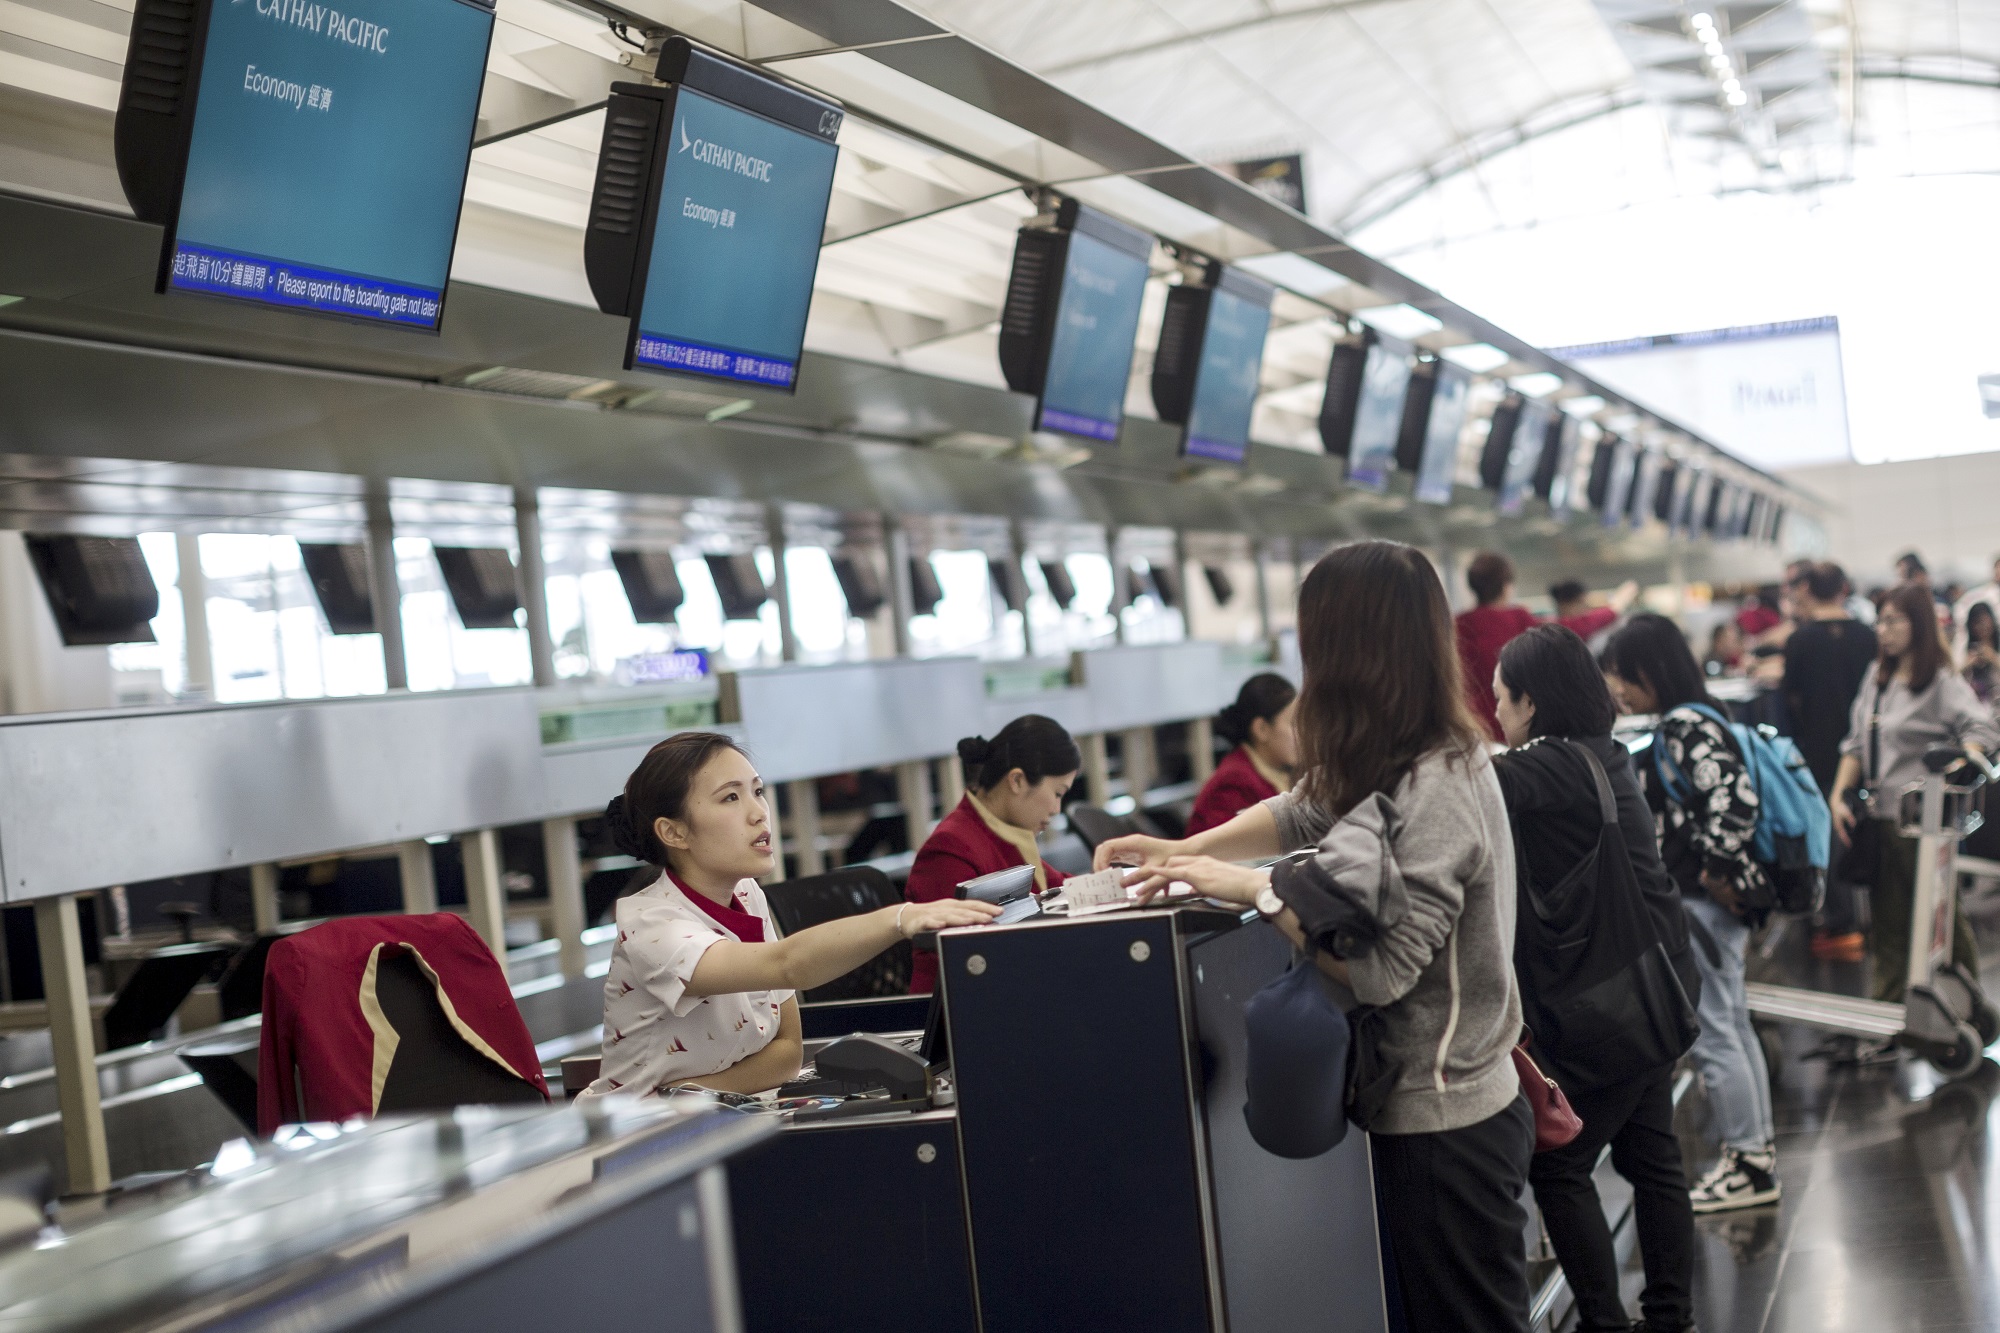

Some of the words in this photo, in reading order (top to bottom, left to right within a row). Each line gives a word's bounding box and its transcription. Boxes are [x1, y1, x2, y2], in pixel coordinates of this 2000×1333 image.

[256, 0, 327, 33] CATHAY
[327, 10, 389, 53] PACIFIC
[244, 64, 306, 110] Economy
[307, 84, 333, 112] 經濟
[818, 110, 842, 137] C34
[692, 138, 736, 170] CATHAY
[734, 151, 773, 183] PACIFIC
[682, 197, 721, 229] Economy
[277, 271, 307, 296] Please
[307, 281, 333, 302] report
[332, 282, 341, 301] to
[342, 284, 356, 304] the
[356, 286, 390, 315] boarding
[389, 295, 408, 315] gate
[407, 298, 421, 315] not
[420, 298, 438, 318] later
